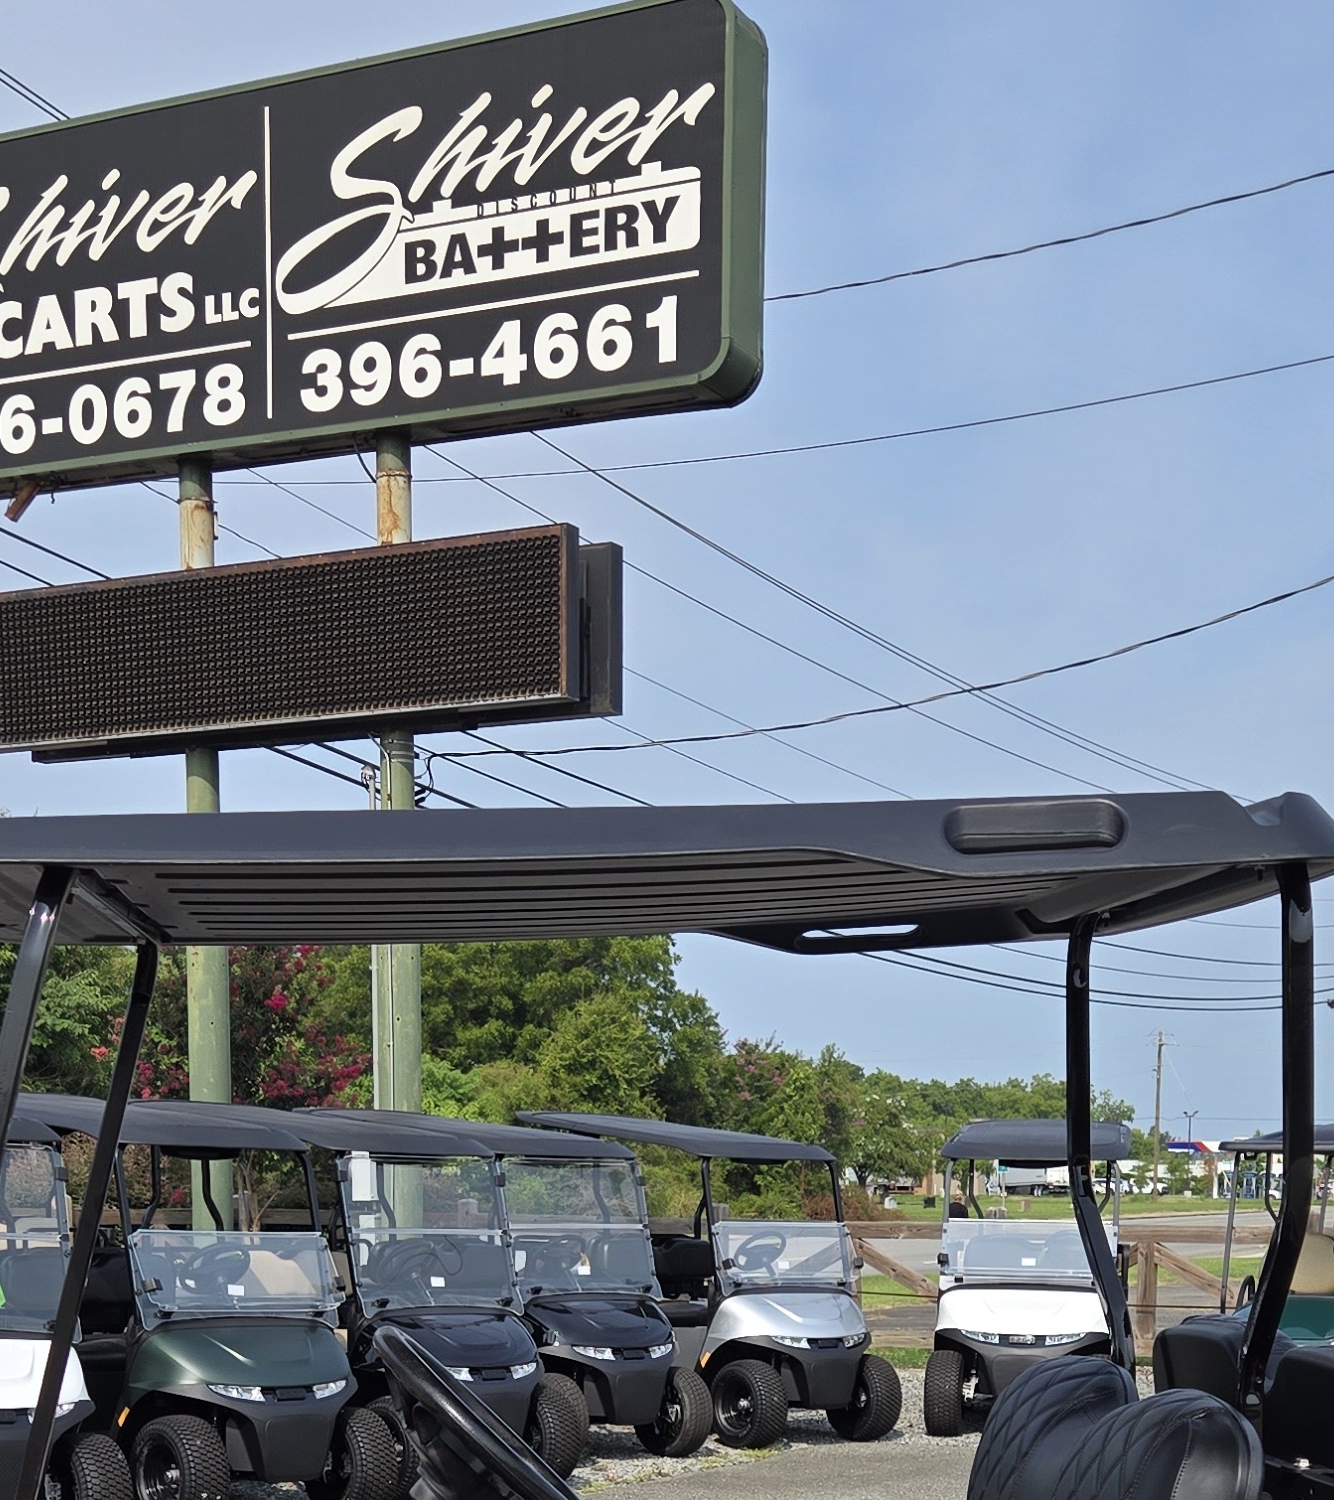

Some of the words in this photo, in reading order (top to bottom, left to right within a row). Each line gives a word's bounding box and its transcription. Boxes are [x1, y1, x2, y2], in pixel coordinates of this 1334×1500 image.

[275, 82, 716, 315] Shiver
[477, 181, 615, 218] DISCOUNT
[204, 287, 260, 325] LLC
[299, 294, 678, 413] 396-4661
